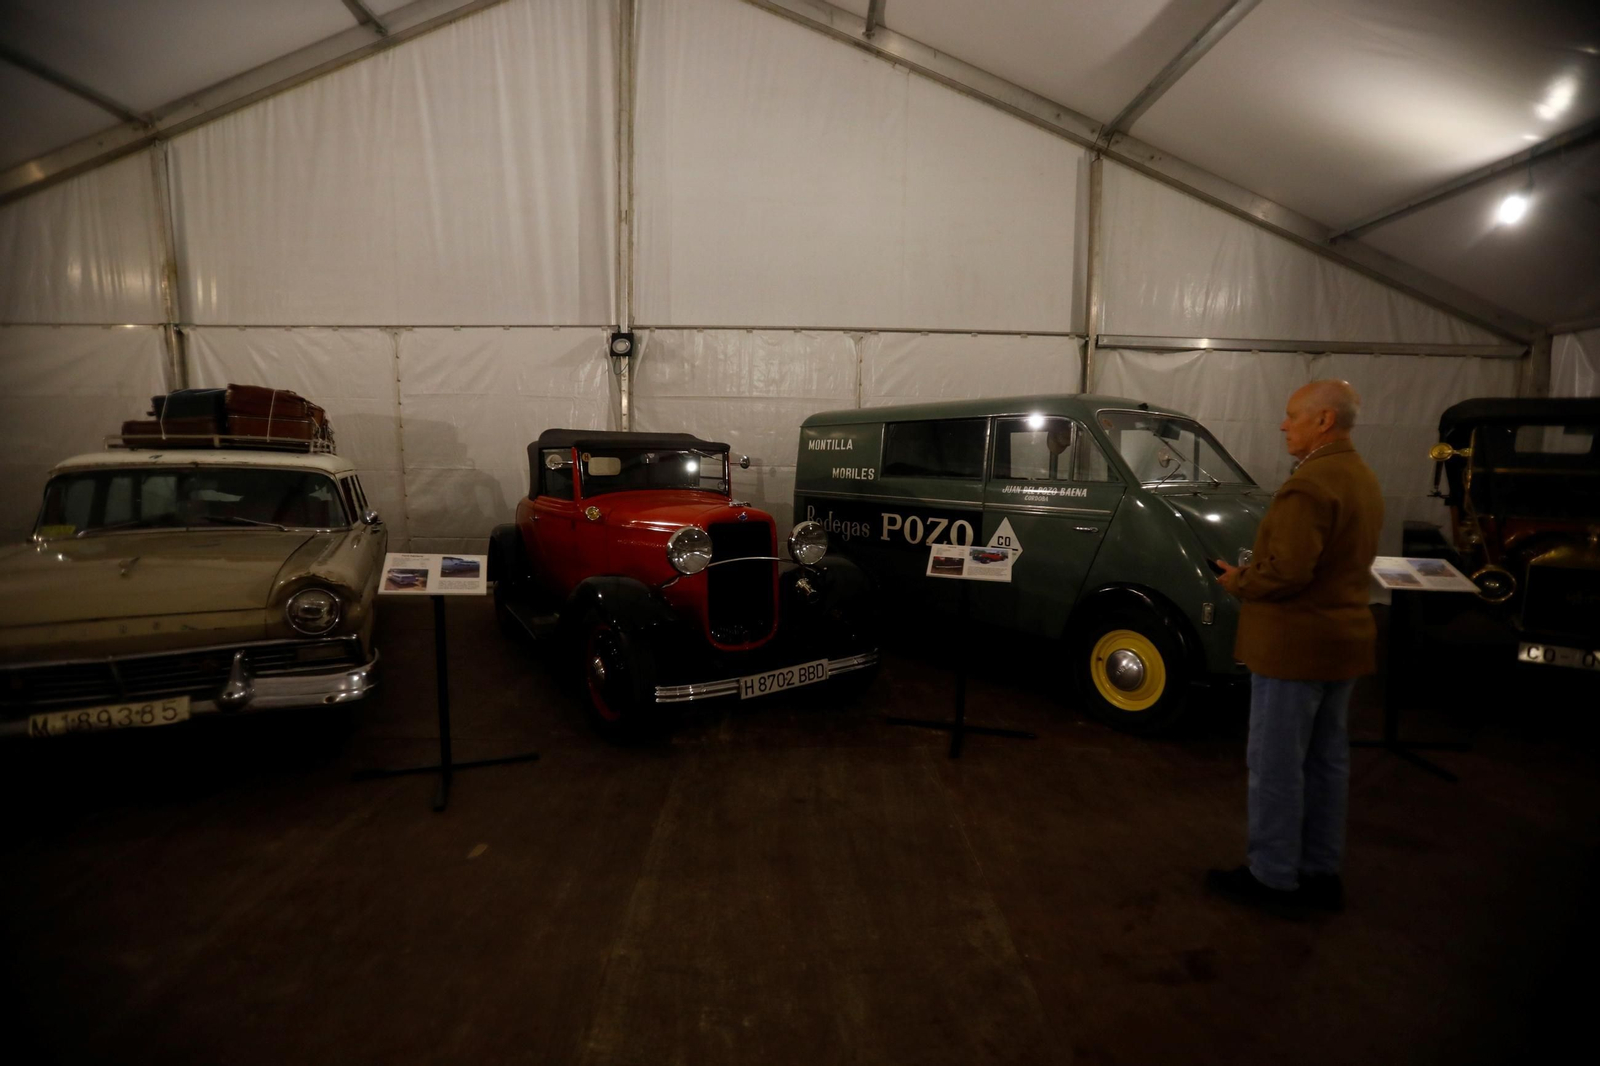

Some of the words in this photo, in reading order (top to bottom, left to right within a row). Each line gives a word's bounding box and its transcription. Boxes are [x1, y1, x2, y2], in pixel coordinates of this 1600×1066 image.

[808, 439, 853, 450] MONTILLA
[832, 467, 875, 480] MORILES
[1002, 485, 1021, 494] JUAN
[1059, 487, 1088, 498] BAENA
[880, 512, 974, 546] POZO
[997, 535, 1011, 546] CO
[744, 679, 755, 696] H
[758, 670, 795, 692] 8702
[799, 663, 825, 684] BBD
